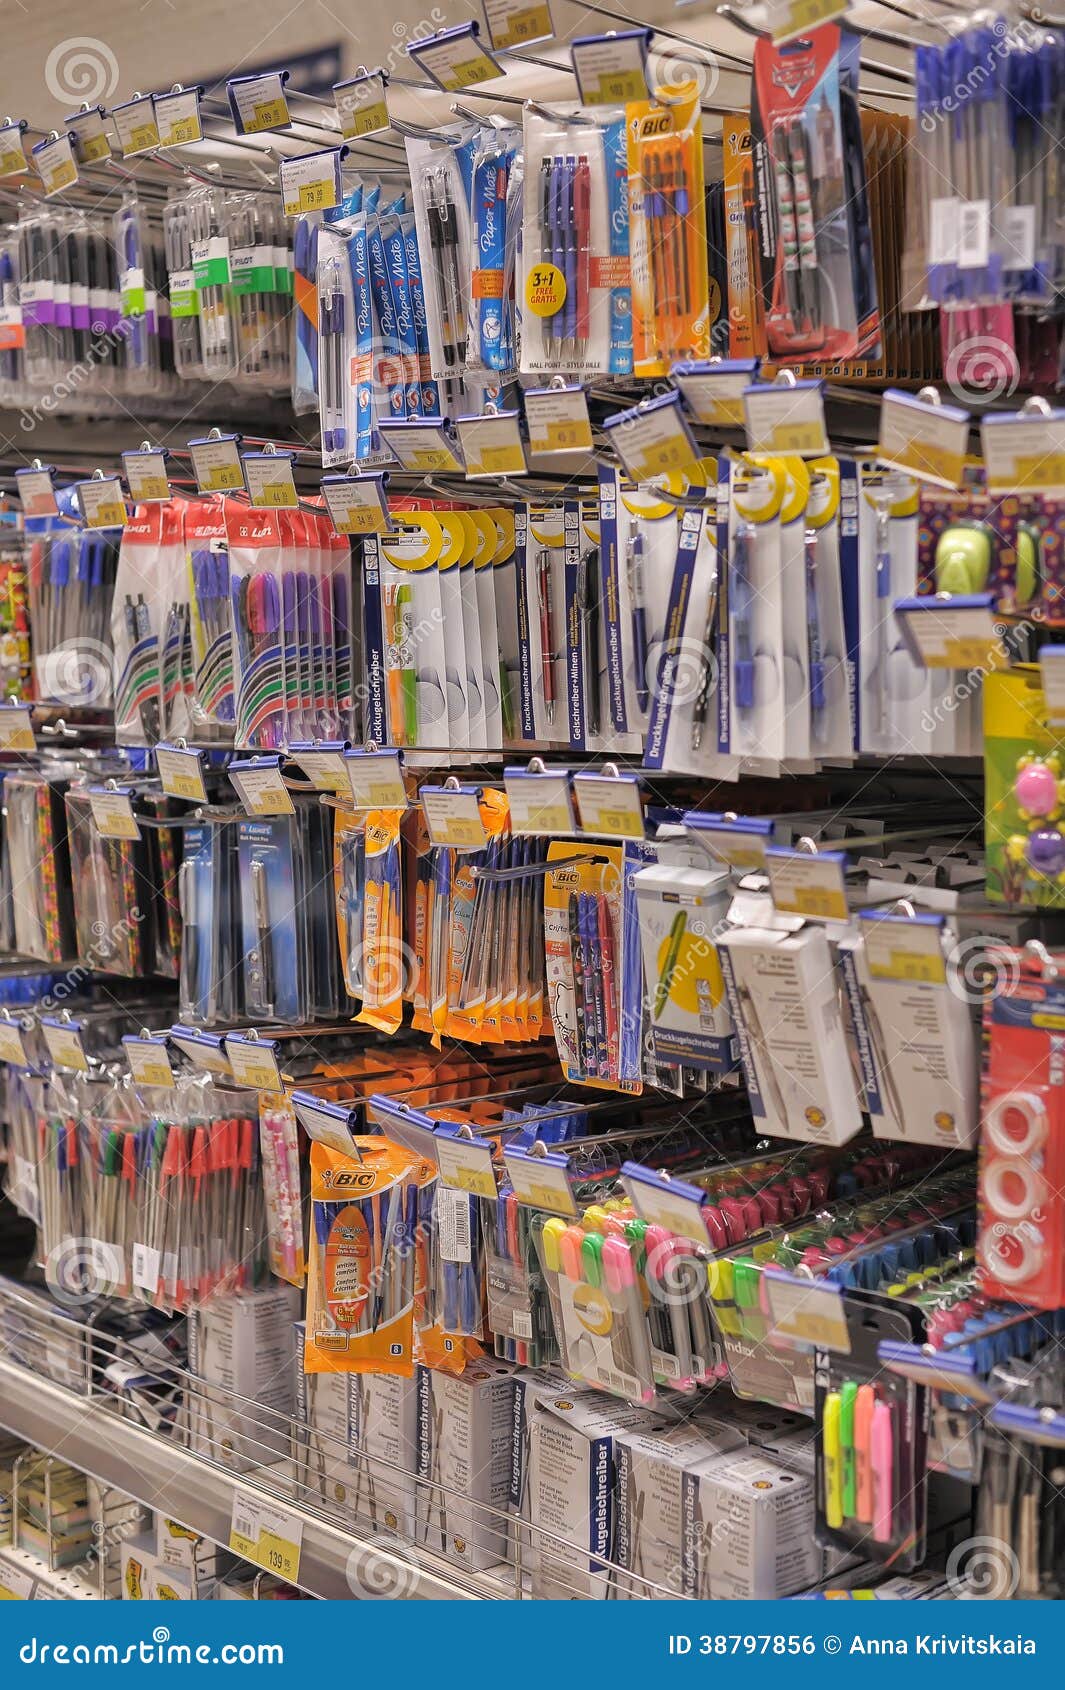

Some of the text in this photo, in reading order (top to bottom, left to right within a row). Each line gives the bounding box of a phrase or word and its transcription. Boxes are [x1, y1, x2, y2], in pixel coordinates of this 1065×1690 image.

[643, 118, 669, 135] BIC
[306, 191, 314, 204] 79
[481, 166, 497, 252] Paper Mate
[235, 255, 253, 266] PILOT
[356, 237, 370, 335] Paper Mate
[375, 239, 395, 336] Paper Mate
[393, 239, 412, 335] Paper Mate
[408, 238, 419, 278] Mate
[531, 295, 557, 303] GRATIS
[533, 272, 554, 287] 3+1
[372, 649, 383, 743] uckkugelschreiber
[521, 645, 532, 731] Druckkugelschreiber
[570, 652, 581, 740] Gelschreiber+Minen
[610, 627, 623, 722] Druckkugelschreiber
[650, 658, 674, 759] Druckkugelschreiber
[373, 830, 388, 842] BIC
[559, 872, 578, 882] BIC
[654, 1030, 720, 1050] Druckkugelschreiber
[336, 1174, 373, 1186] BIC
[336, 1268, 358, 1276] comfort
[393, 1345, 400, 1353] 8
[418, 1370, 431, 1479] Kugelschreiber
[510, 1385, 523, 1496] Kugelschreiber
[595, 1444, 608, 1560] Kugelschreiber
[618, 1449, 629, 1567] Kugelschreiber
[684, 1477, 696, 1598] Kugelschreiber
[269, 1550, 283, 1569] 139
